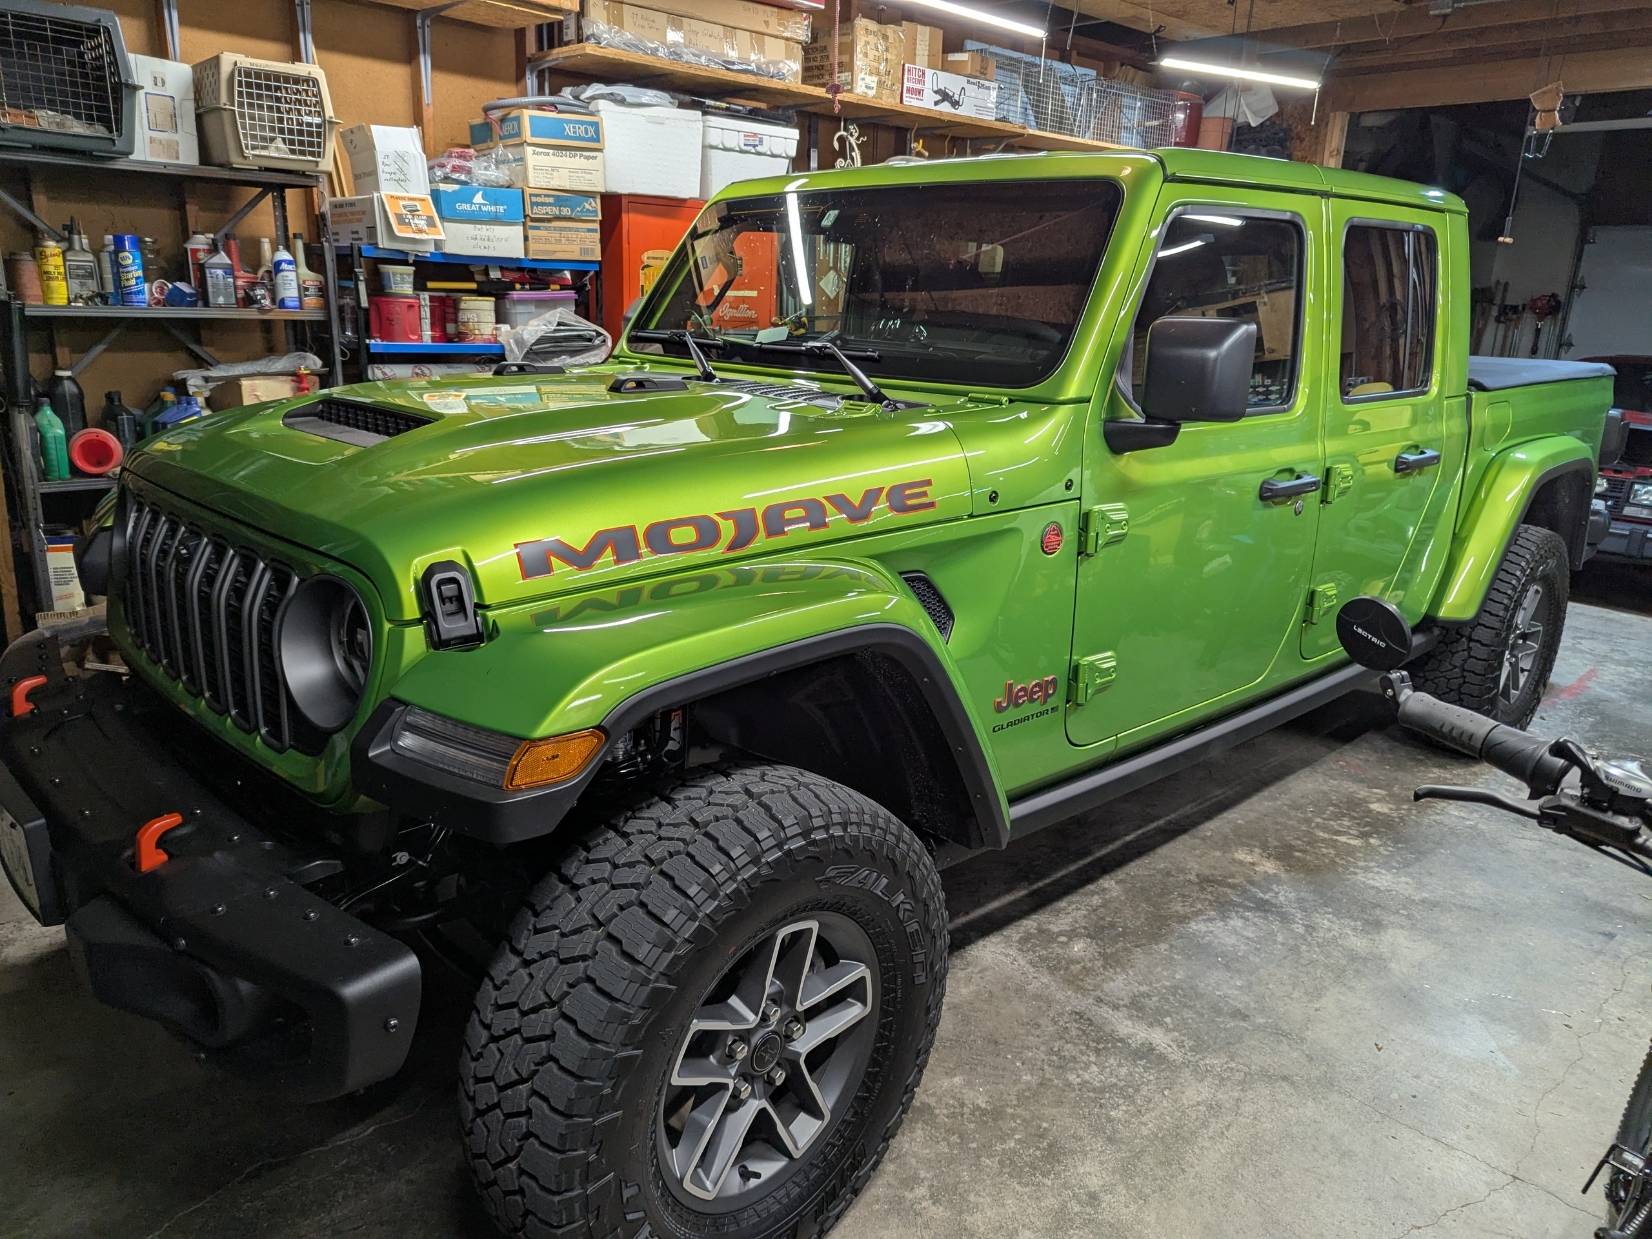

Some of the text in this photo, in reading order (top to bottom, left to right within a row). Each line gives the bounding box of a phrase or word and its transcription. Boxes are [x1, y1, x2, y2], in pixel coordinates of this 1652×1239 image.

[907, 66, 926, 79] HITCH
[905, 86, 925, 98] MOUNT
[563, 122, 596, 138] XEROX
[532, 149, 550, 157] Xerox
[579, 153, 598, 161] Paper
[455, 203, 480, 211] GREAT
[481, 204, 505, 213] WHITE
[532, 206, 571, 216] ASPEN 30
[513, 478, 937, 581] MOJAVE
[992, 674, 1058, 714] Jeep
[992, 707, 1050, 734] GLADIATOR
[815, 864, 928, 985] FALKEN
